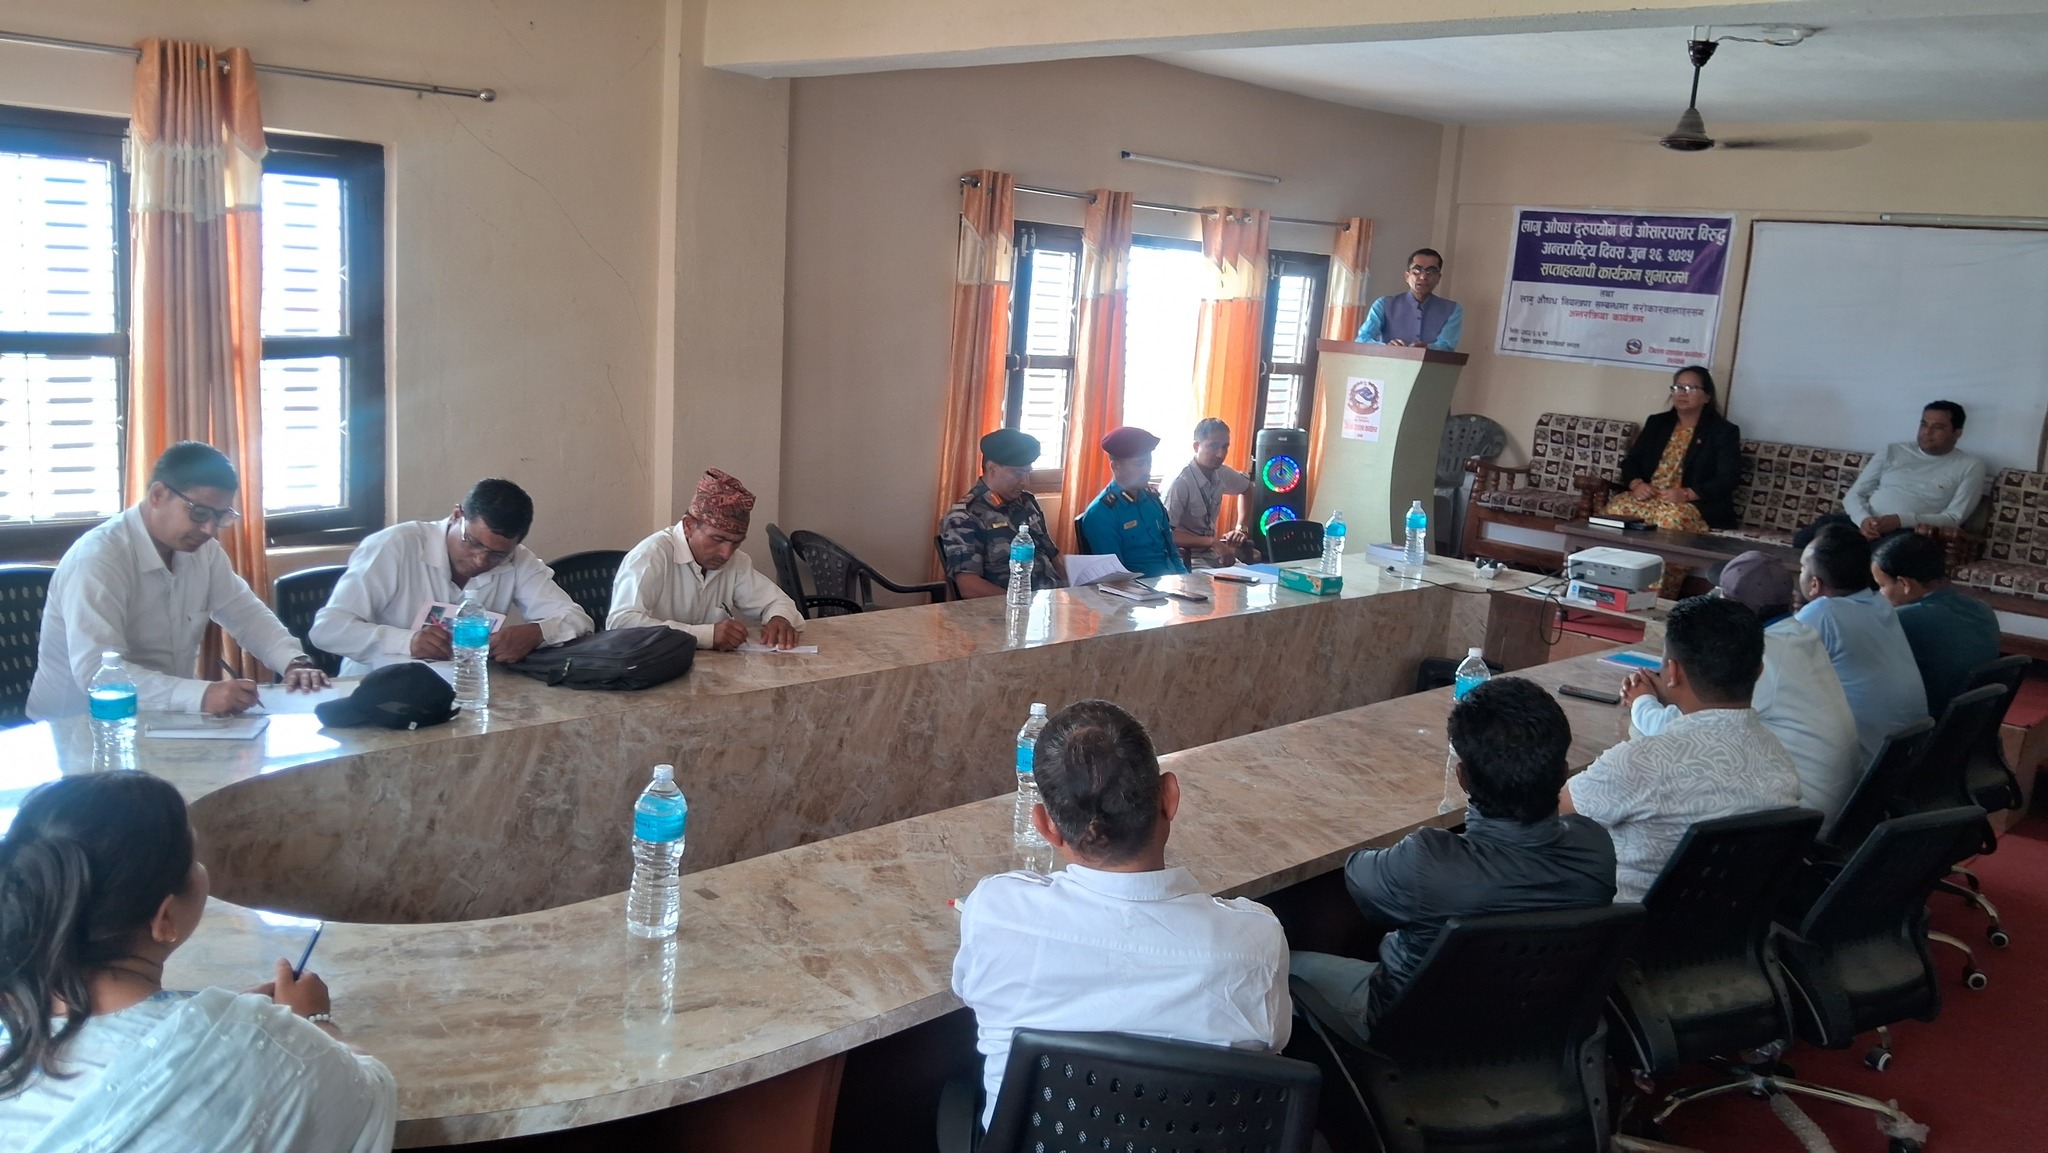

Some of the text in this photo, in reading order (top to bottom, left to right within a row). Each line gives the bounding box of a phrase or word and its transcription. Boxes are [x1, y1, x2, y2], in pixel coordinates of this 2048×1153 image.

[1599, 241, 1626, 260] दिवस
[1627, 246, 1648, 263] जुन
[1667, 249, 1695, 264] २०२५
[1598, 264, 1643, 281] कार्यक्रम
